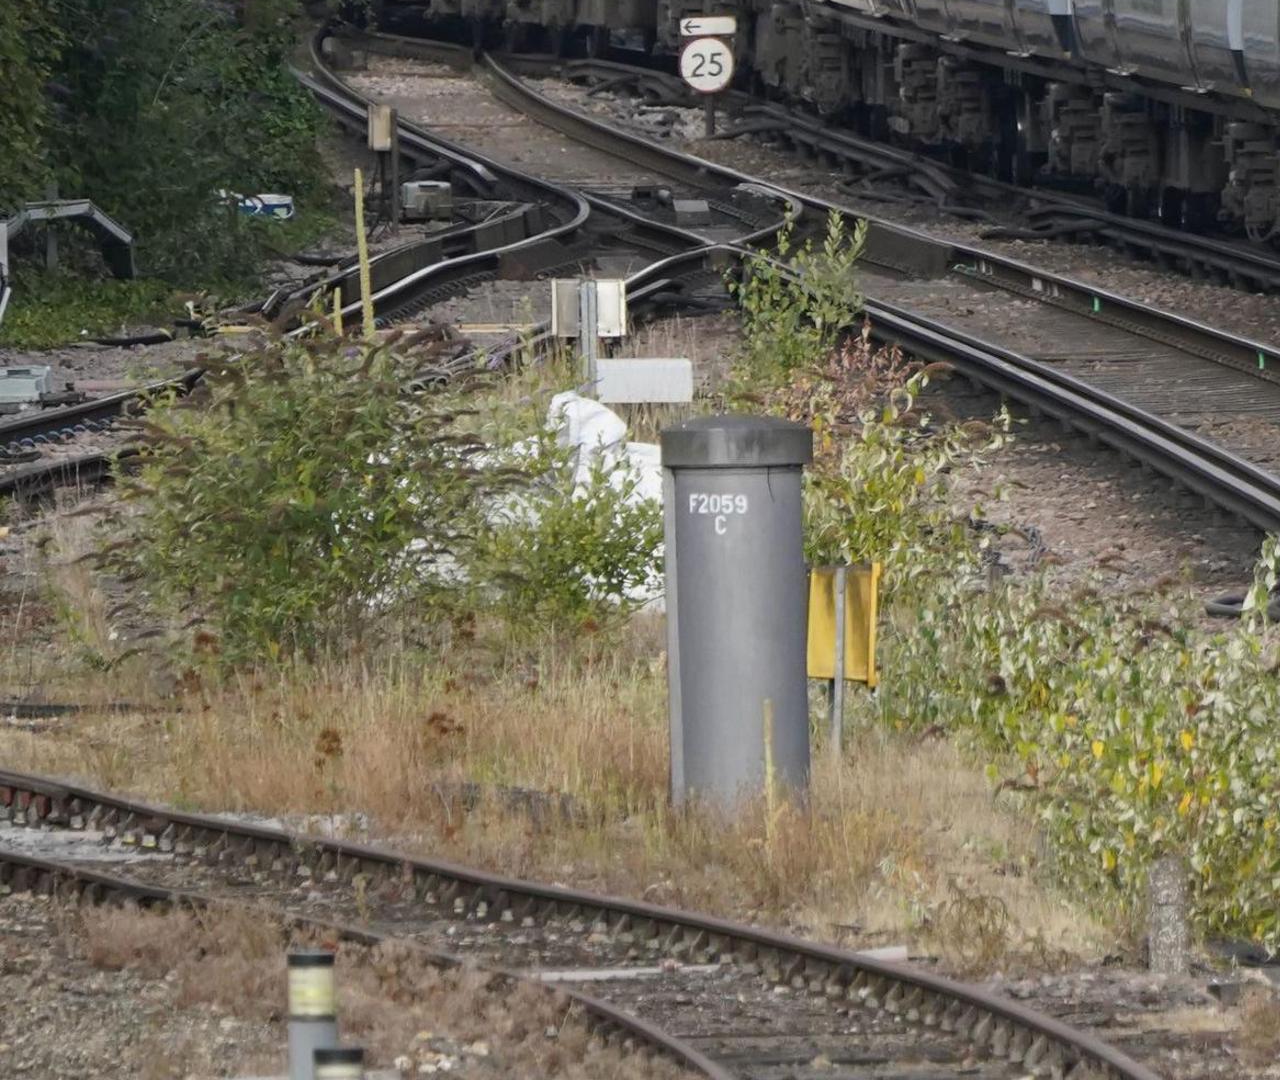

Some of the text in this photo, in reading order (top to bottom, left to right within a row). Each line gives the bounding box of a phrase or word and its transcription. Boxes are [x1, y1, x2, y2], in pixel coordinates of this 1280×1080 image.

[691, 52, 723, 77] 25
[689, 493, 747, 513] F2059
[714, 515, 726, 535] C
